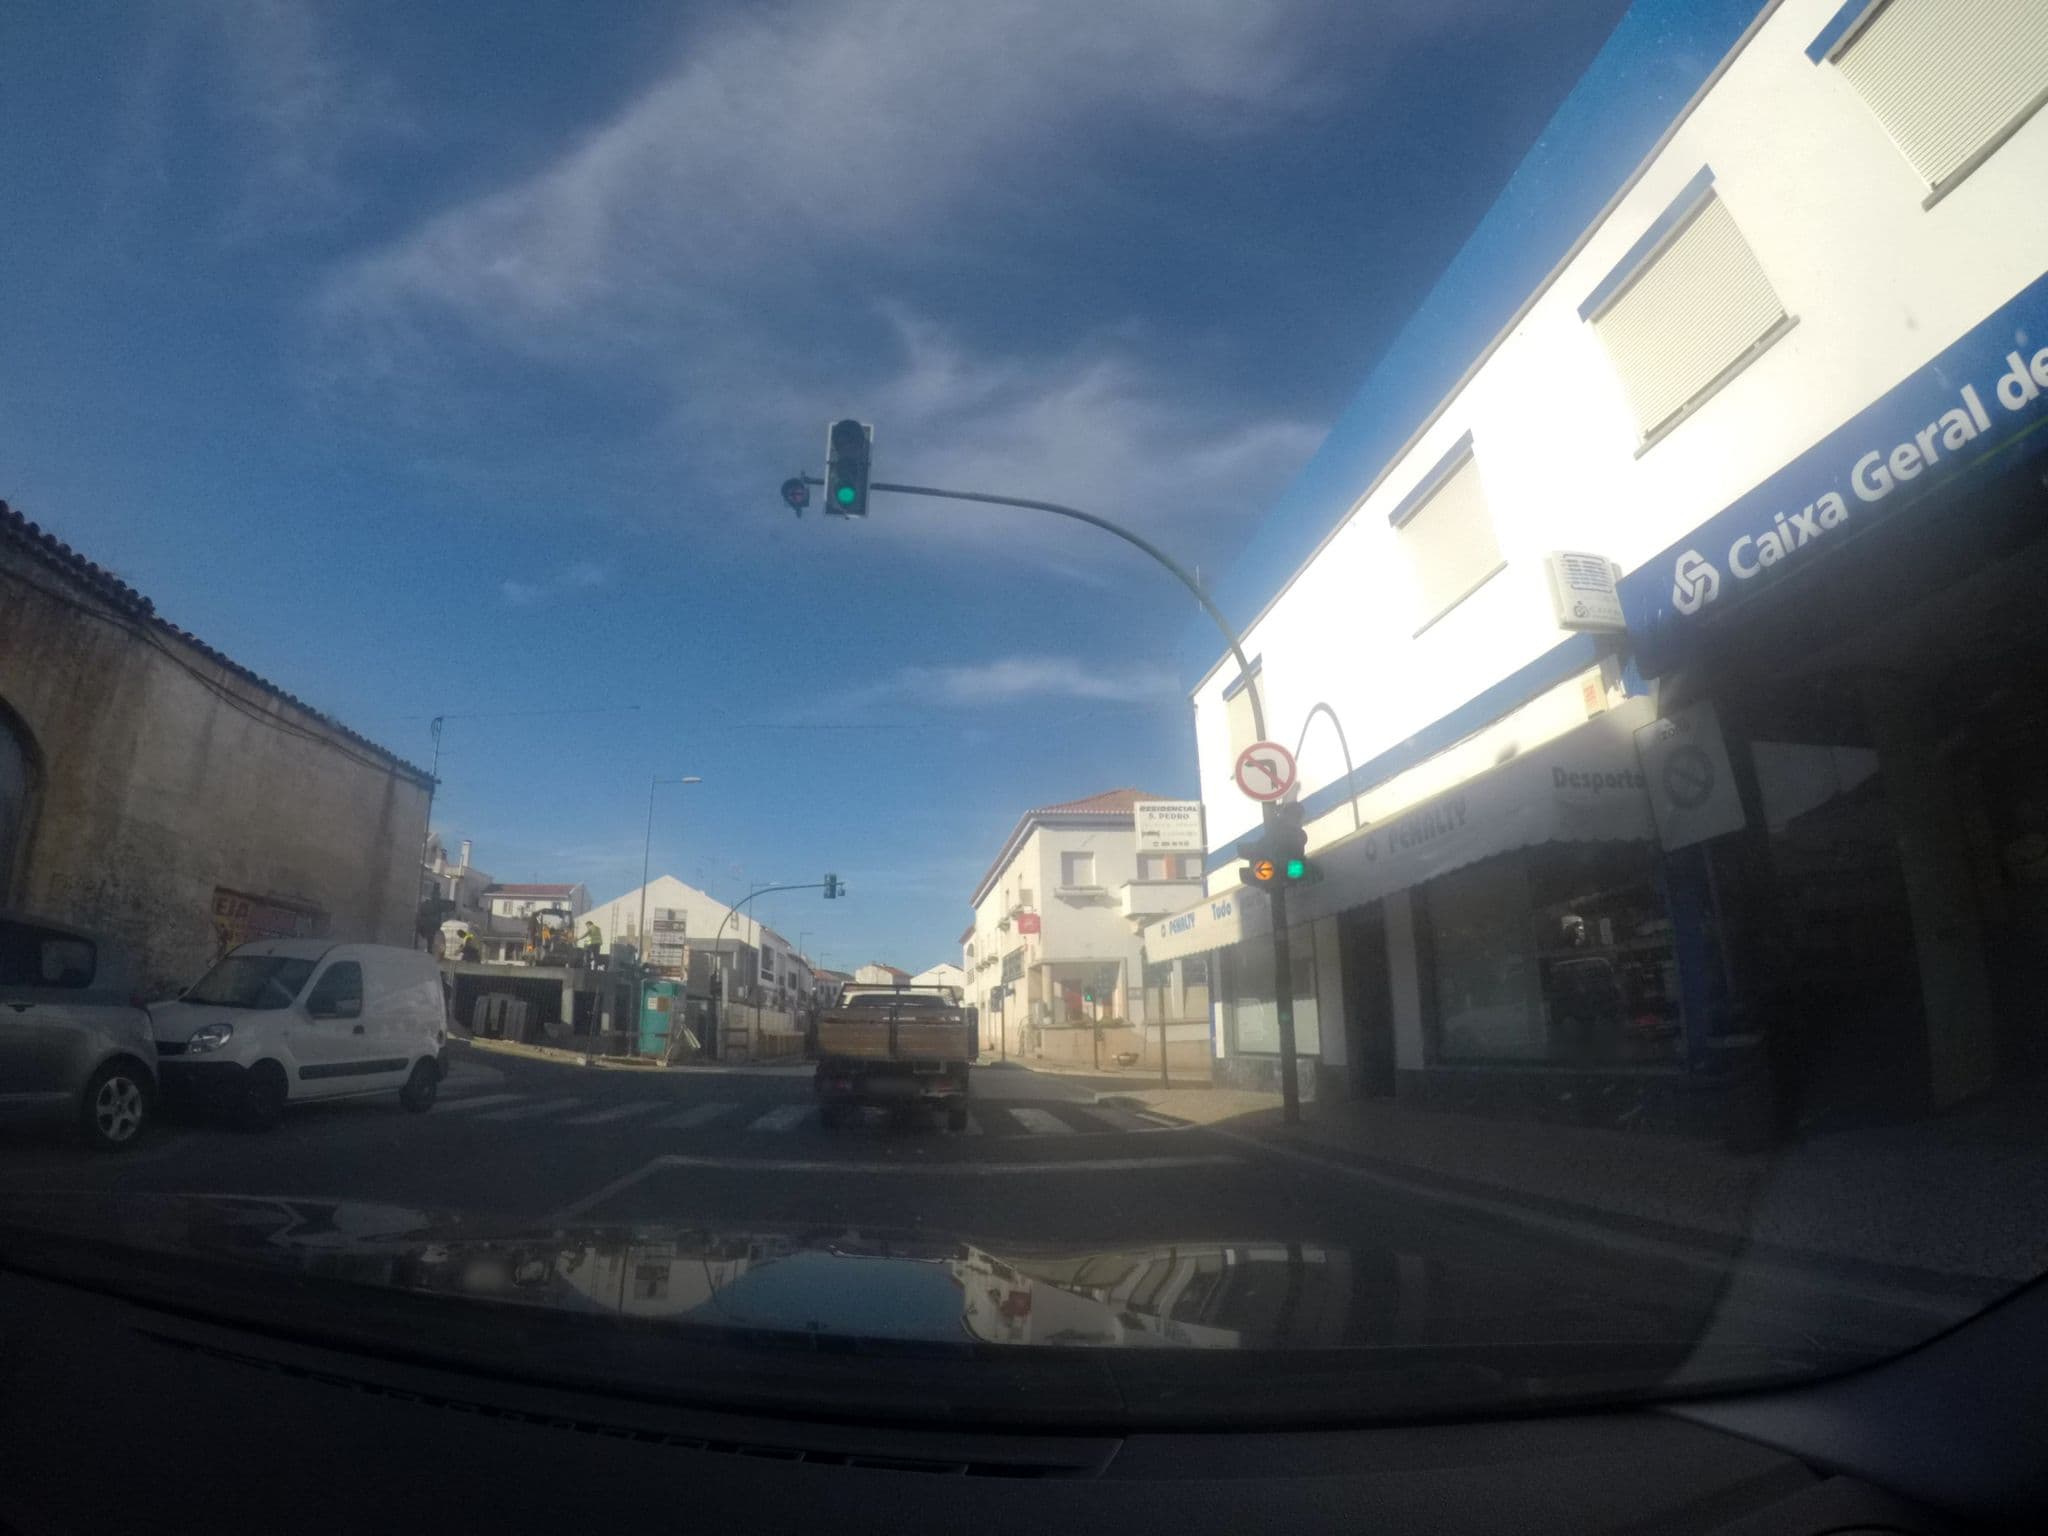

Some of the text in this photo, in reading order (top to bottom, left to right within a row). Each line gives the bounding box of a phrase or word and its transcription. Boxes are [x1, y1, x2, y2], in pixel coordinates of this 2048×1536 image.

[1728, 347, 2048, 579] Caixa Geral de
[1158, 812, 1190, 821] PEDRO
